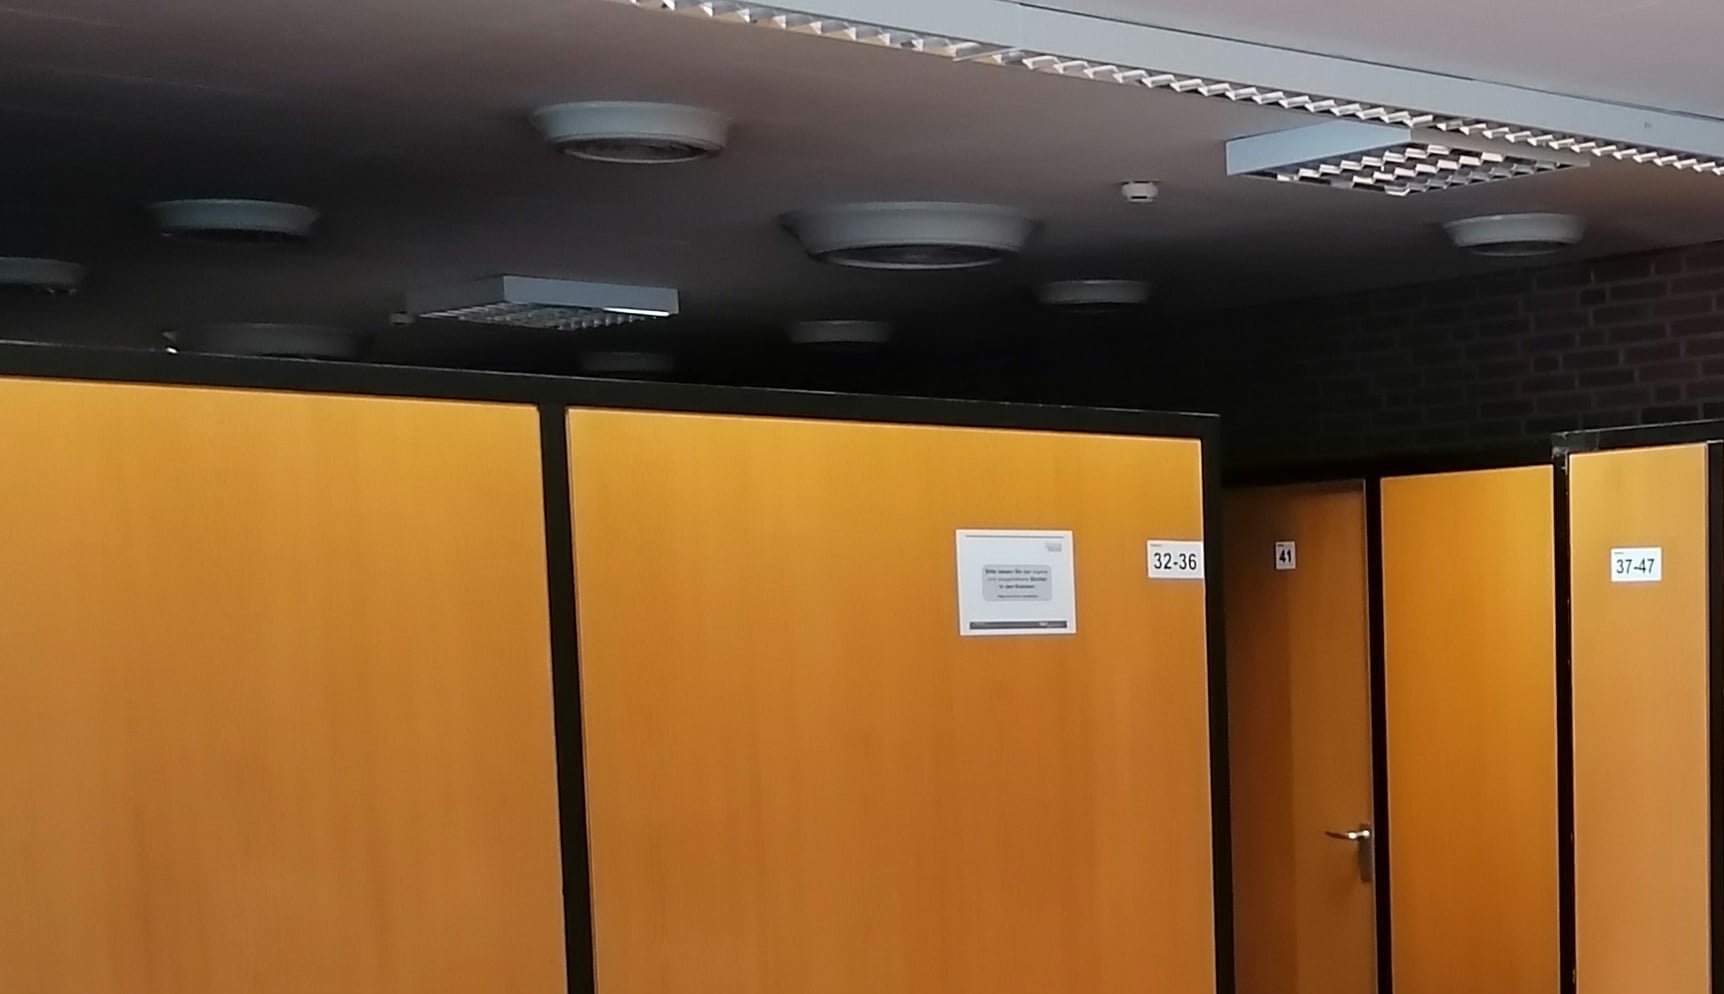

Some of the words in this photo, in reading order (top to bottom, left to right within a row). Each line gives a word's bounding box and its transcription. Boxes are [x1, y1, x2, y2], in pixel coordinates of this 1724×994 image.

[1154, 552, 1197, 571] 32-36
[1279, 549, 1292, 563] 41
[1616, 557, 1655, 574] 37-47
